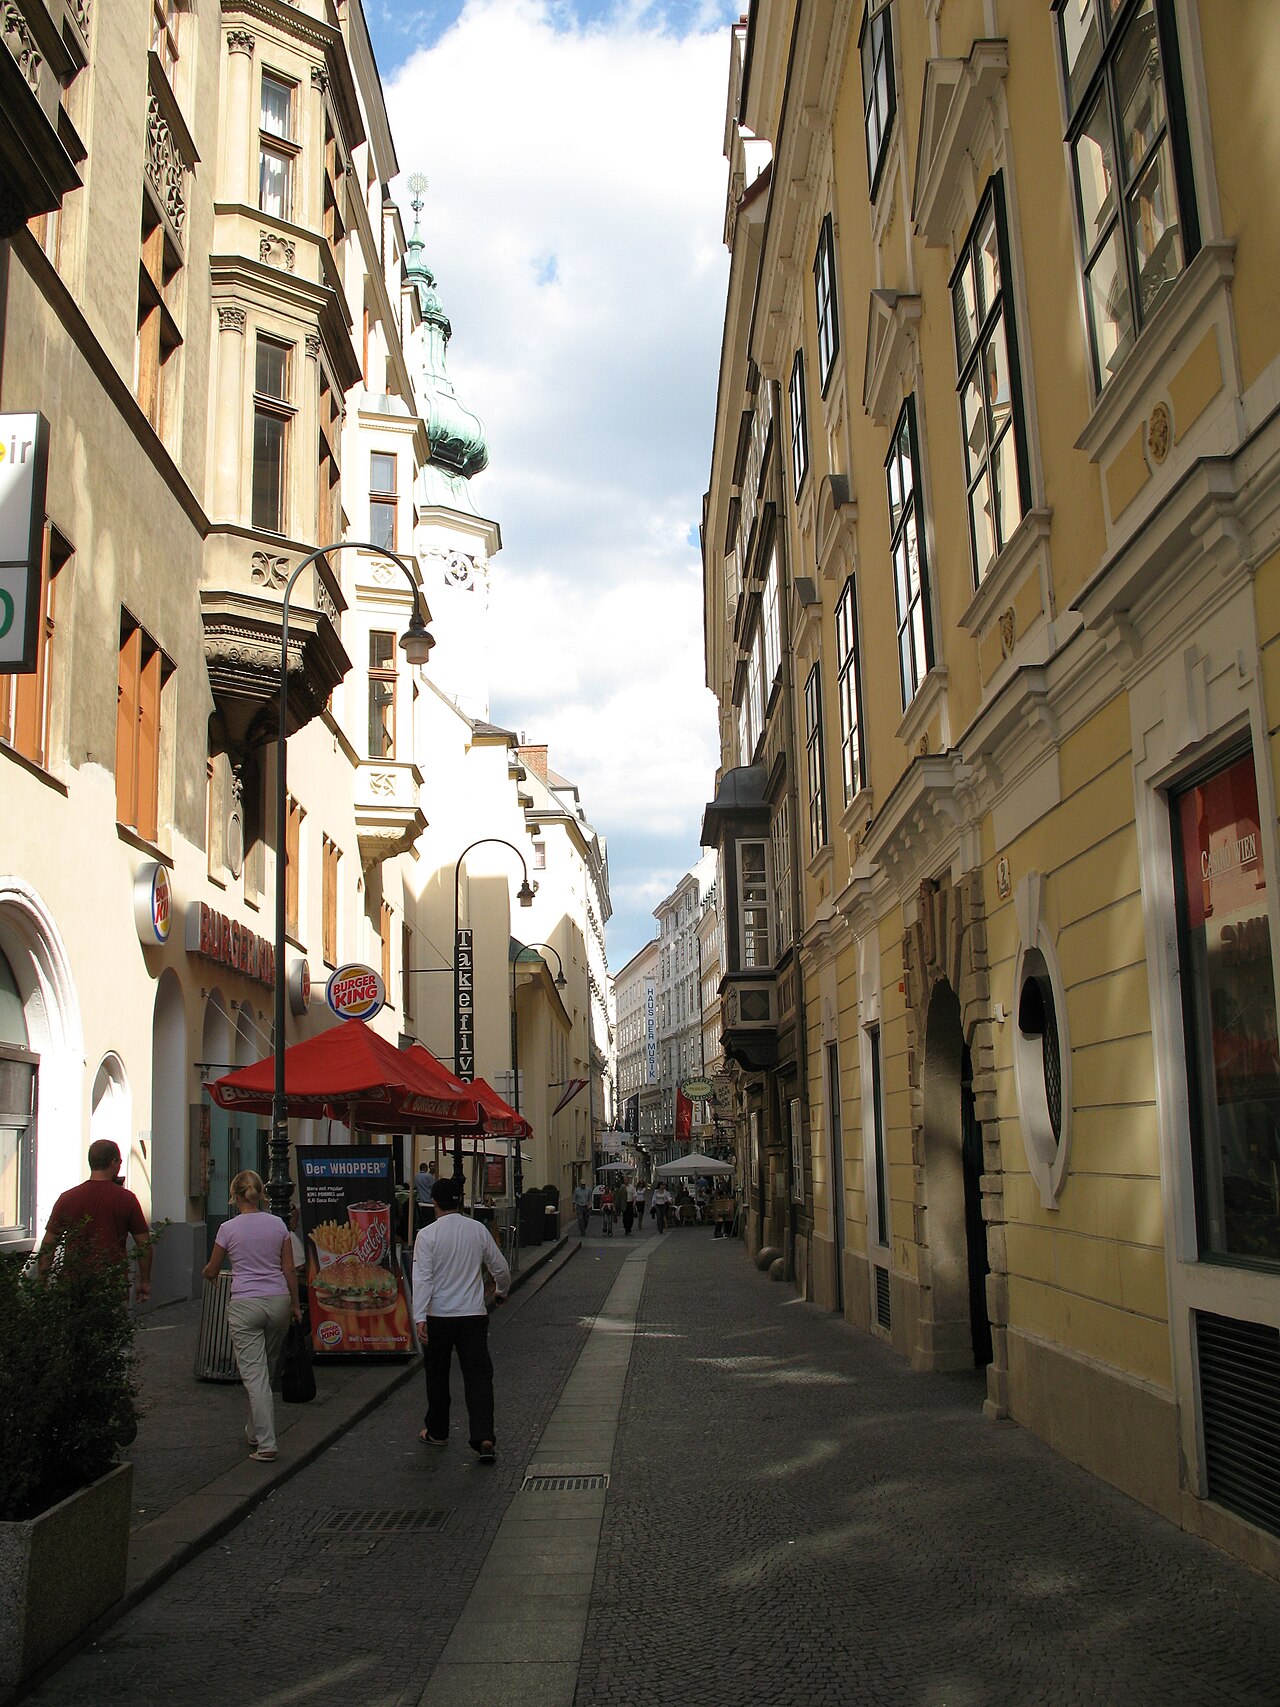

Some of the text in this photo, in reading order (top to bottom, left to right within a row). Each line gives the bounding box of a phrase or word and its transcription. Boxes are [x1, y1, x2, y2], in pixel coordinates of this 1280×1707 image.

[1233, 833, 1257, 864] WIEN
[333, 975, 376, 996] BURGER
[335, 985, 378, 1010] KING
[647, 1043, 656, 1078] MUSIK
[306, 1163, 326, 1174] Der
